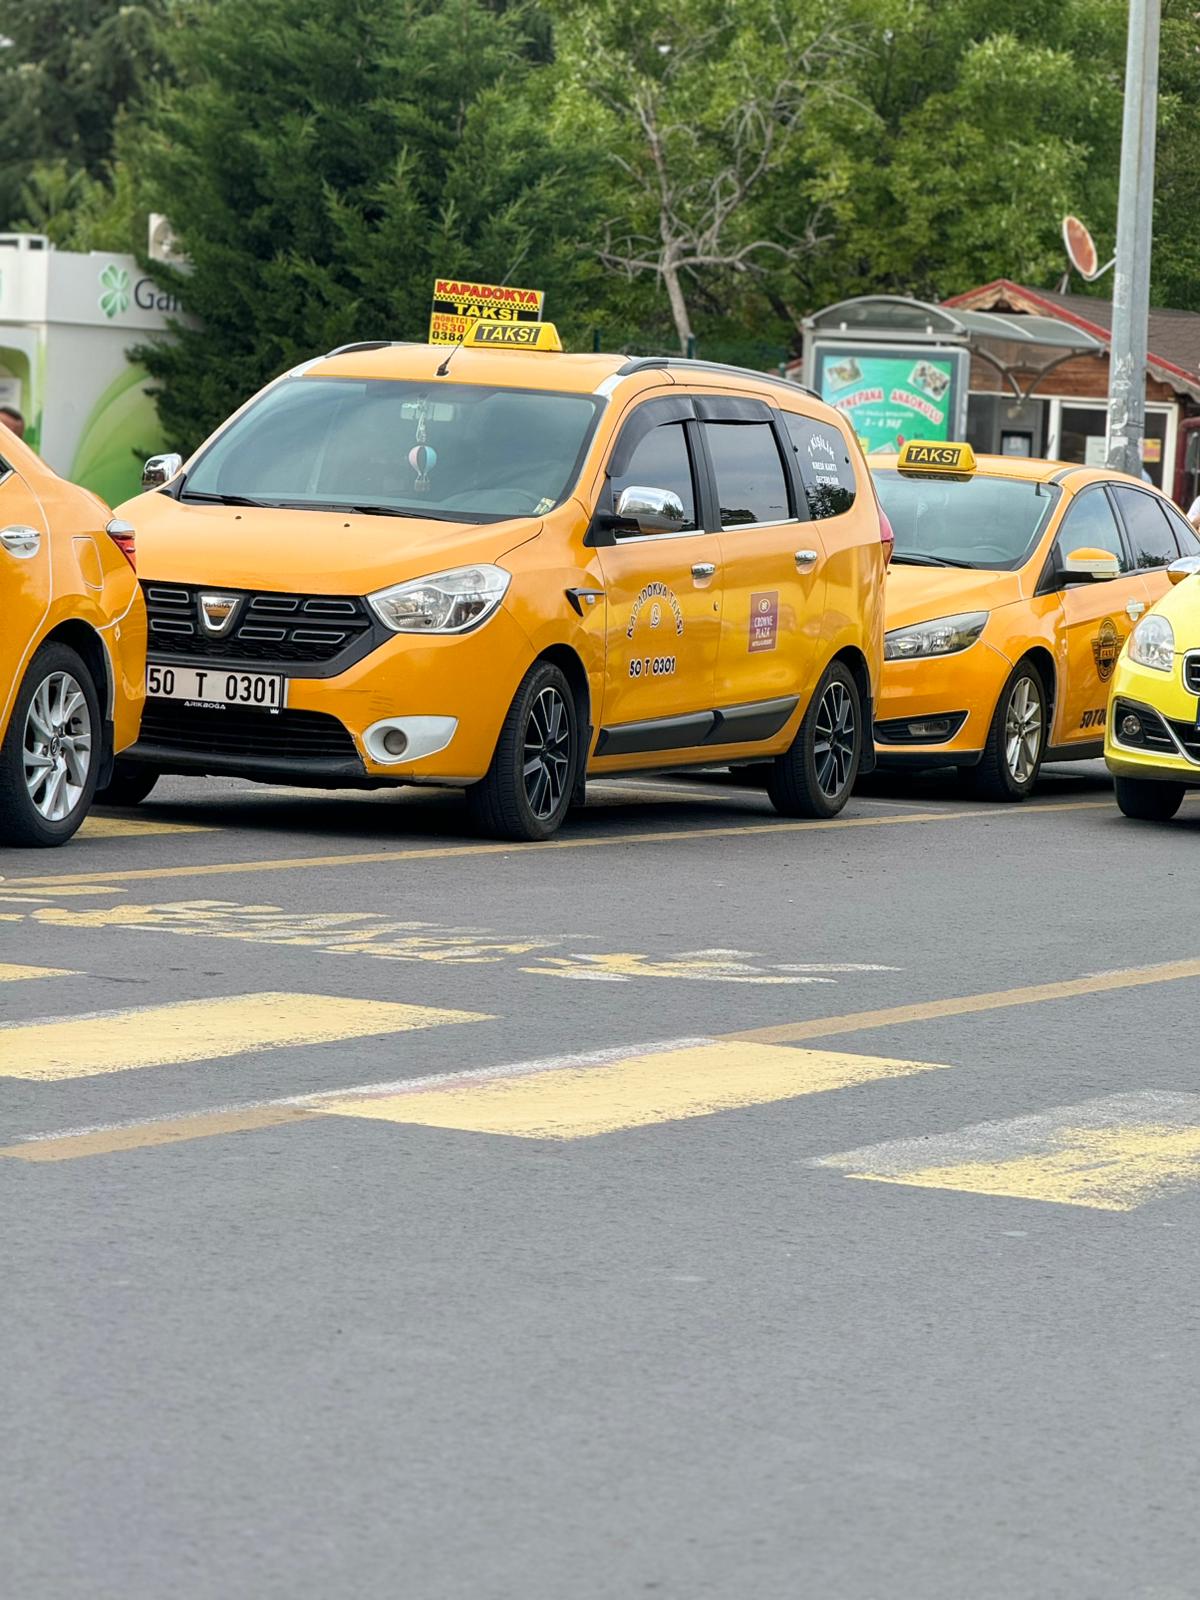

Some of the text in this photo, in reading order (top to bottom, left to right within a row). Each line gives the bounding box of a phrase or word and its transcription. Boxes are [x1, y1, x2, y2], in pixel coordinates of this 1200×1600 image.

[436, 281, 539, 304] KAPADOKYA
[432, 330, 464, 342] 0384
[433, 321, 465, 333] 0530
[626, 582, 668, 639] KAPADOKYA
[629, 657, 676, 677] 50 T 0301
[149, 668, 276, 704] 50 T 0301
